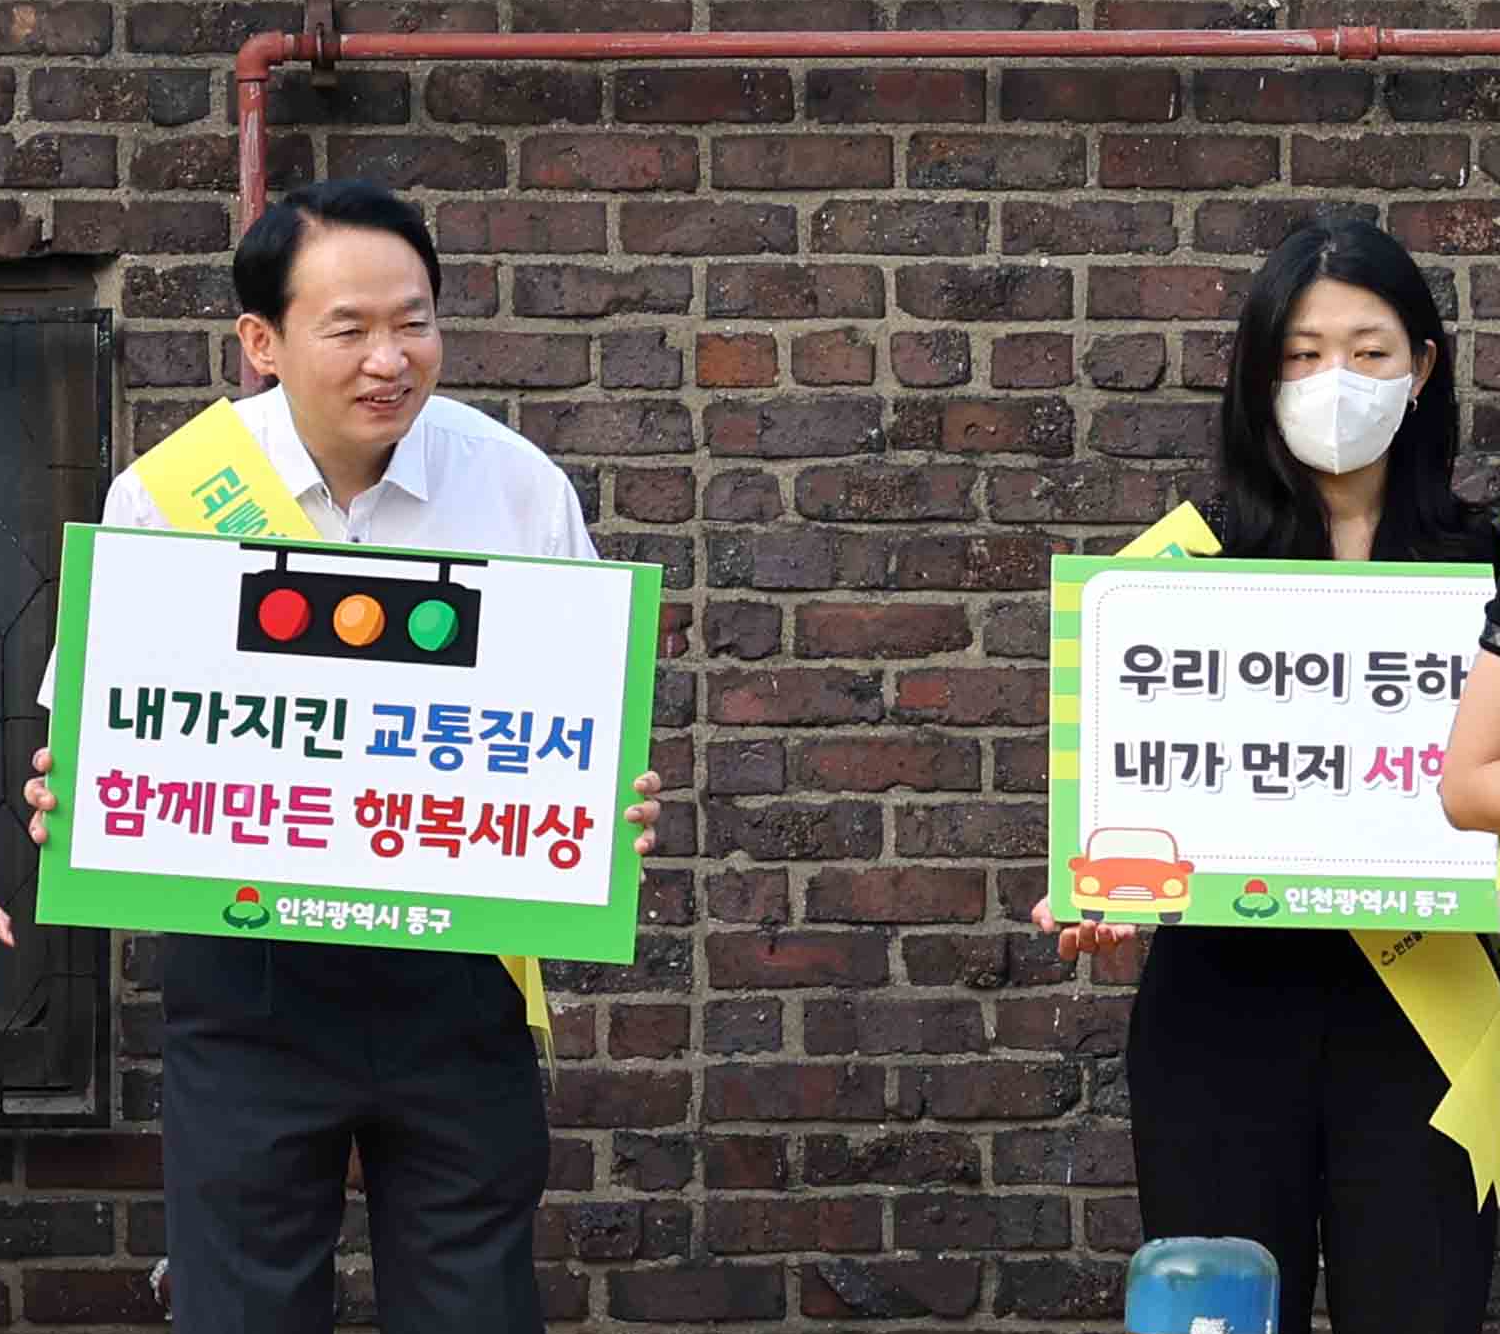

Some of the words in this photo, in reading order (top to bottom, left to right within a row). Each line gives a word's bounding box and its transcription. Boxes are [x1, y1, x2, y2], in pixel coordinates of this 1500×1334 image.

[1119, 643, 1220, 697] 우리
[1238, 651, 1345, 698] 아이
[1364, 651, 1468, 708] 등하
[107, 686, 349, 761] 내가지킨
[365, 703, 595, 775] 교통질서
[1113, 740, 1224, 789] 내가
[1241, 741, 1346, 794] 먼저
[96, 769, 335, 850] 함께만든
[353, 787, 594, 870] 행복세상
[275, 896, 400, 932] 인천광역시
[405, 904, 452, 935] 동구
[1284, 886, 1408, 917] 인천광역시
[1413, 891, 1459, 918] 동구
